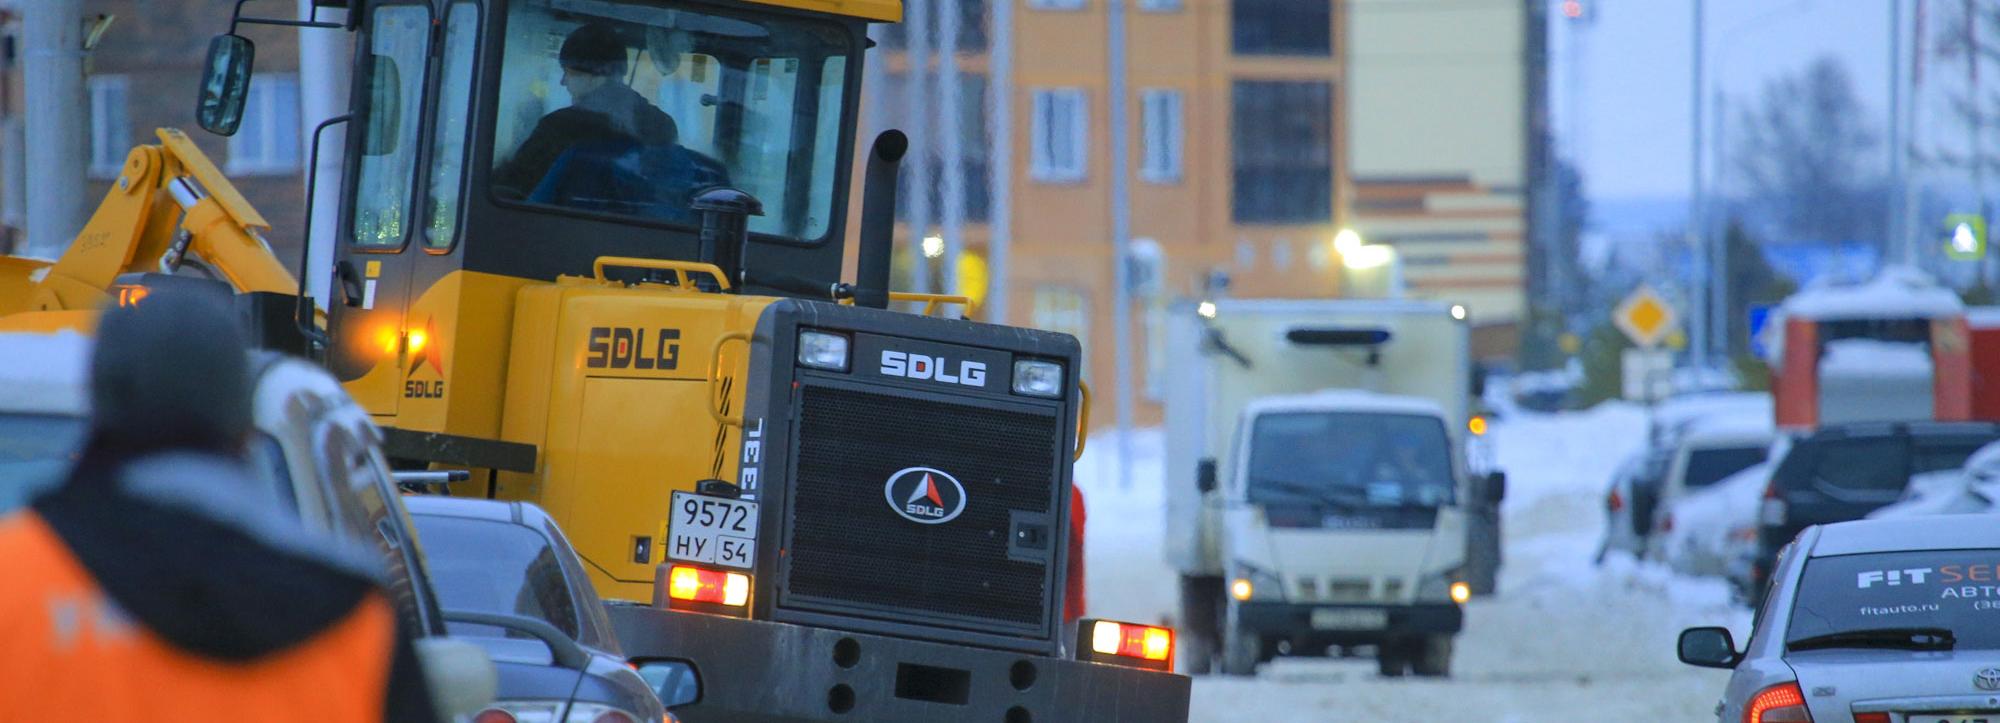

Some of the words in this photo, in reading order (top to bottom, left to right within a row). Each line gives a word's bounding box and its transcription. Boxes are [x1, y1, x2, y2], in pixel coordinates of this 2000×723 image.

[587, 327, 681, 370] SDLG
[880, 350, 987, 387] SDLG
[404, 380, 443, 398] SDLG
[684, 499, 748, 532] 9572
[906, 504, 944, 517] SDLG
[722, 541, 747, 563] 54
[1940, 563, 2000, 583] SE
[1941, 585, 2000, 599] АВТ
[1860, 603, 1940, 616] fitauto.ru
